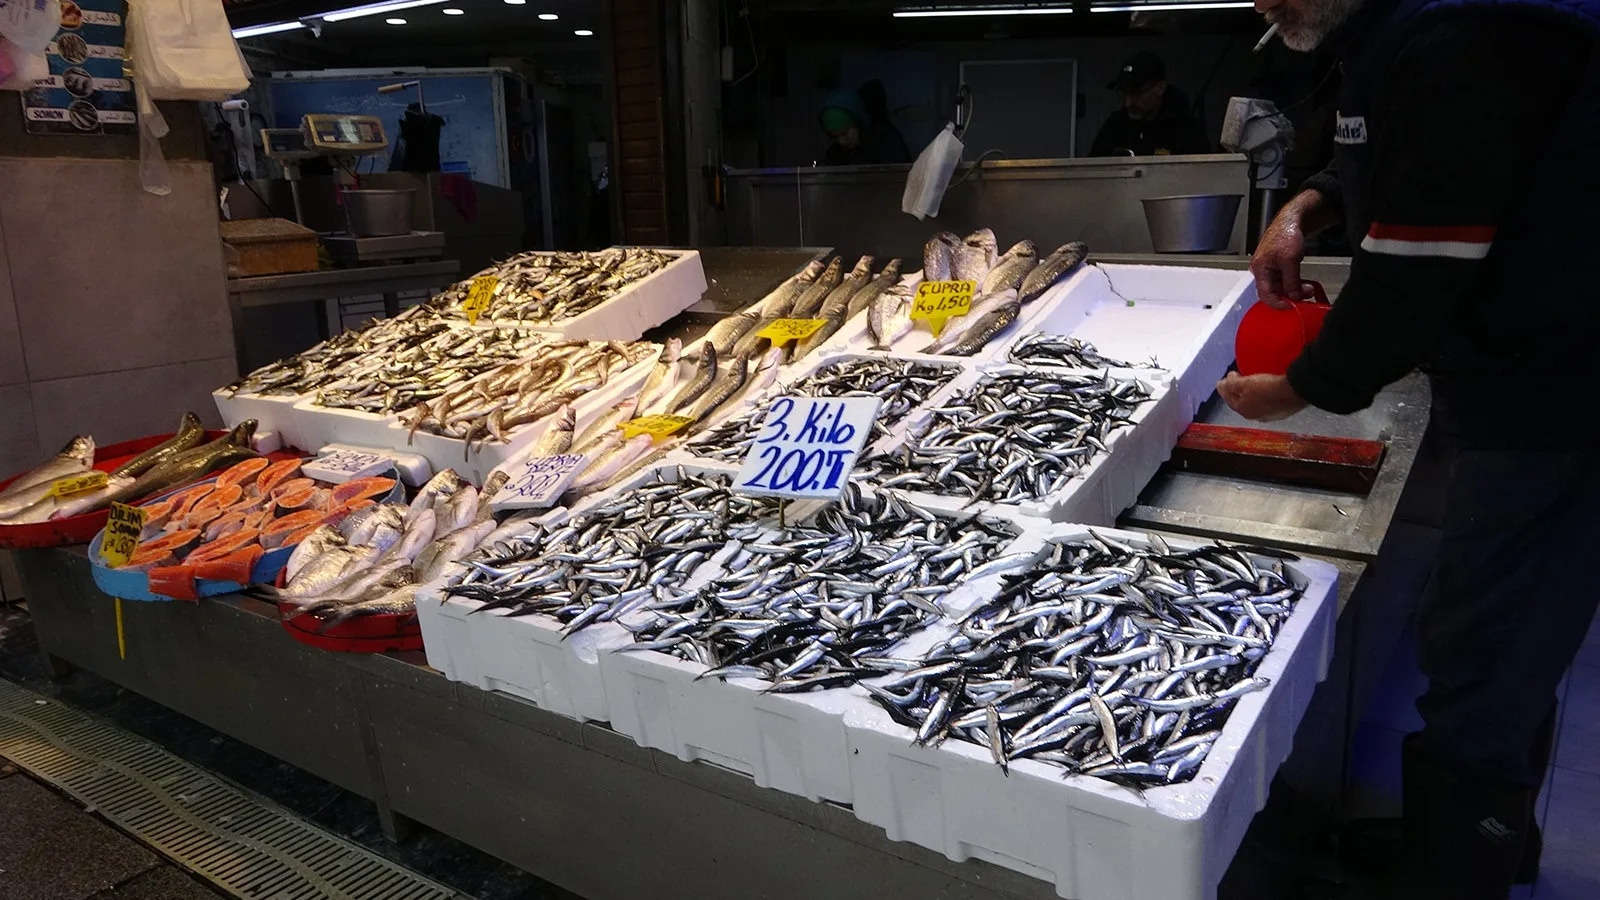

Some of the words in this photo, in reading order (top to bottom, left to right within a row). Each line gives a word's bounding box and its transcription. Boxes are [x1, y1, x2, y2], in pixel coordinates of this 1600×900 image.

[33, 110, 64, 119] SOMON
[919, 282, 971, 297] ÇUPRA
[915, 300, 934, 314] Kg
[936, 295, 971, 311] 450
[794, 401, 855, 444] Kilo
